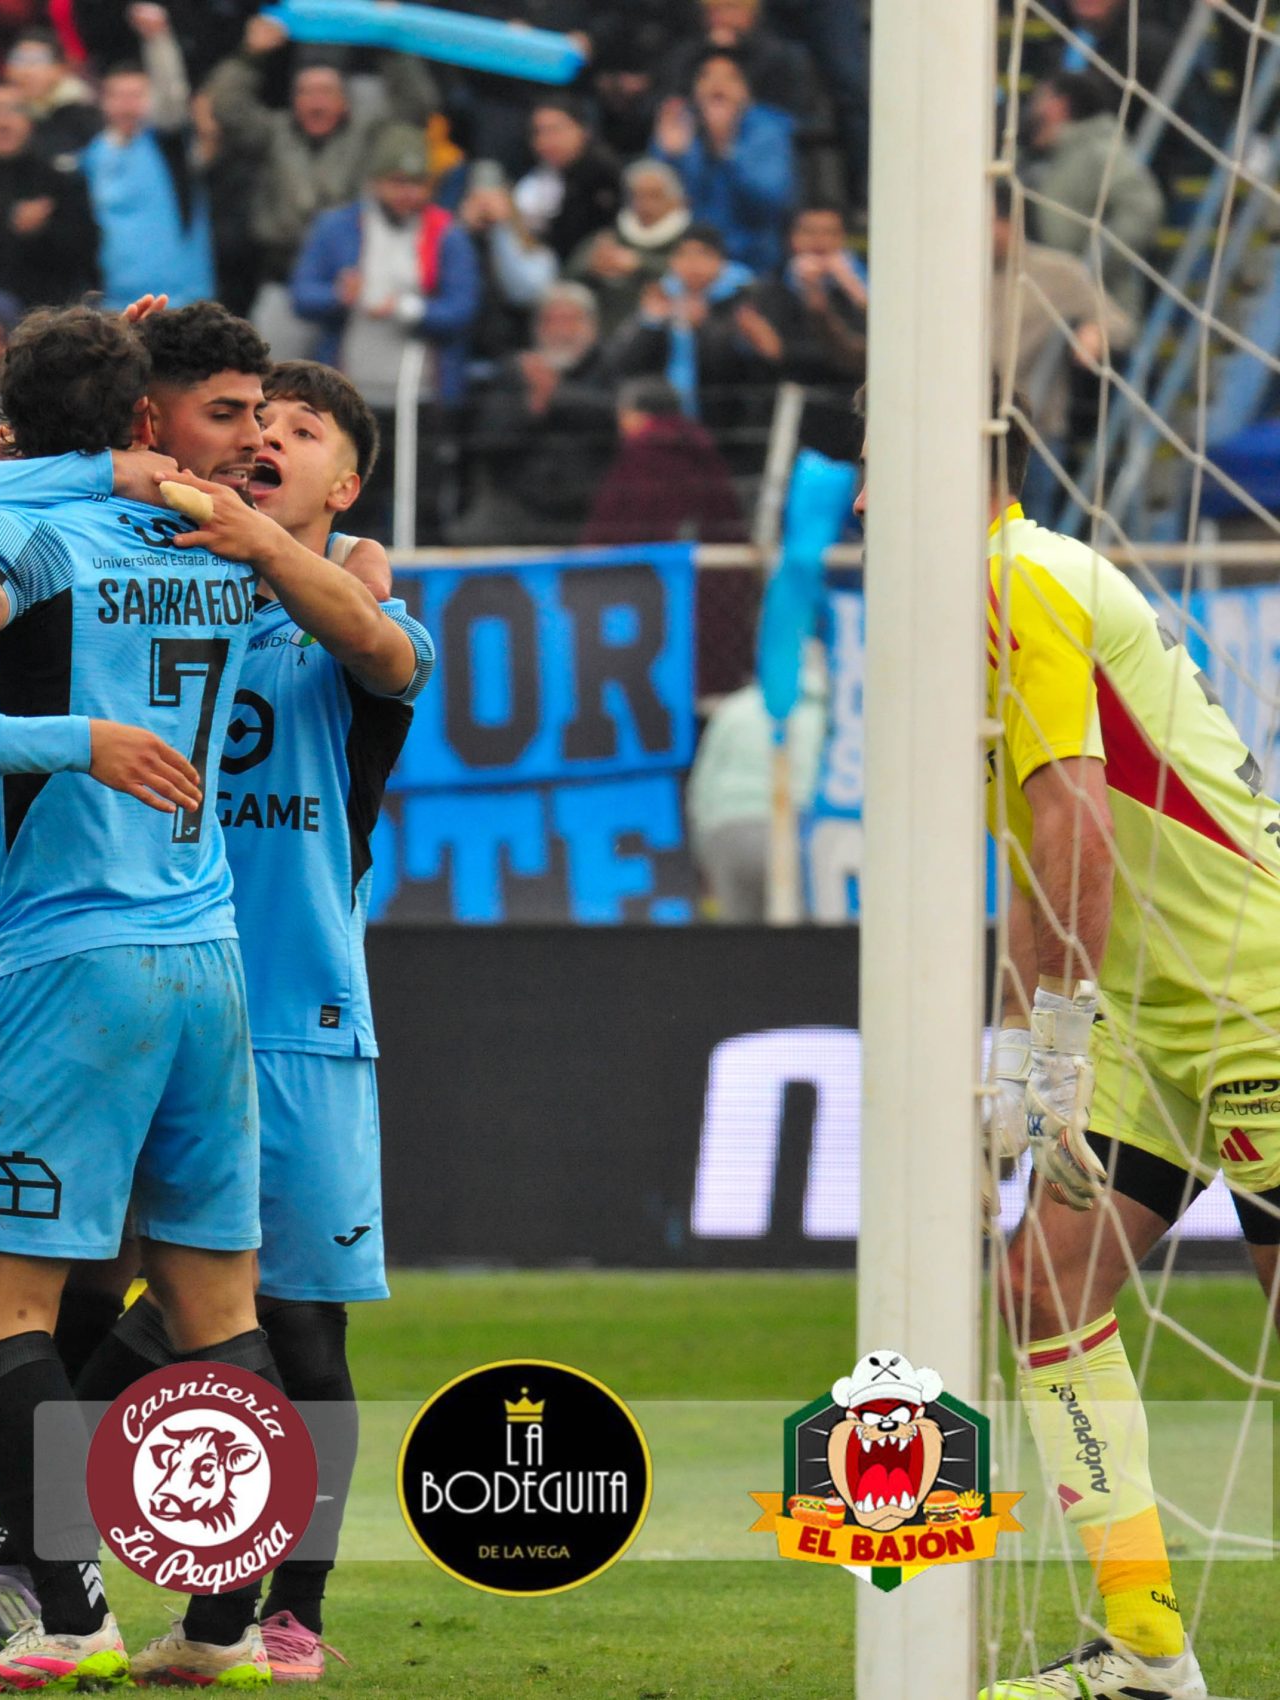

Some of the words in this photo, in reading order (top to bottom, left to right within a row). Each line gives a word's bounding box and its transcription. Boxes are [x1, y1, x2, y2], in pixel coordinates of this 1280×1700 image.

[92, 554, 168, 569] Universidad
[171, 553, 209, 566] Estatal
[150, 637, 230, 843] 7
